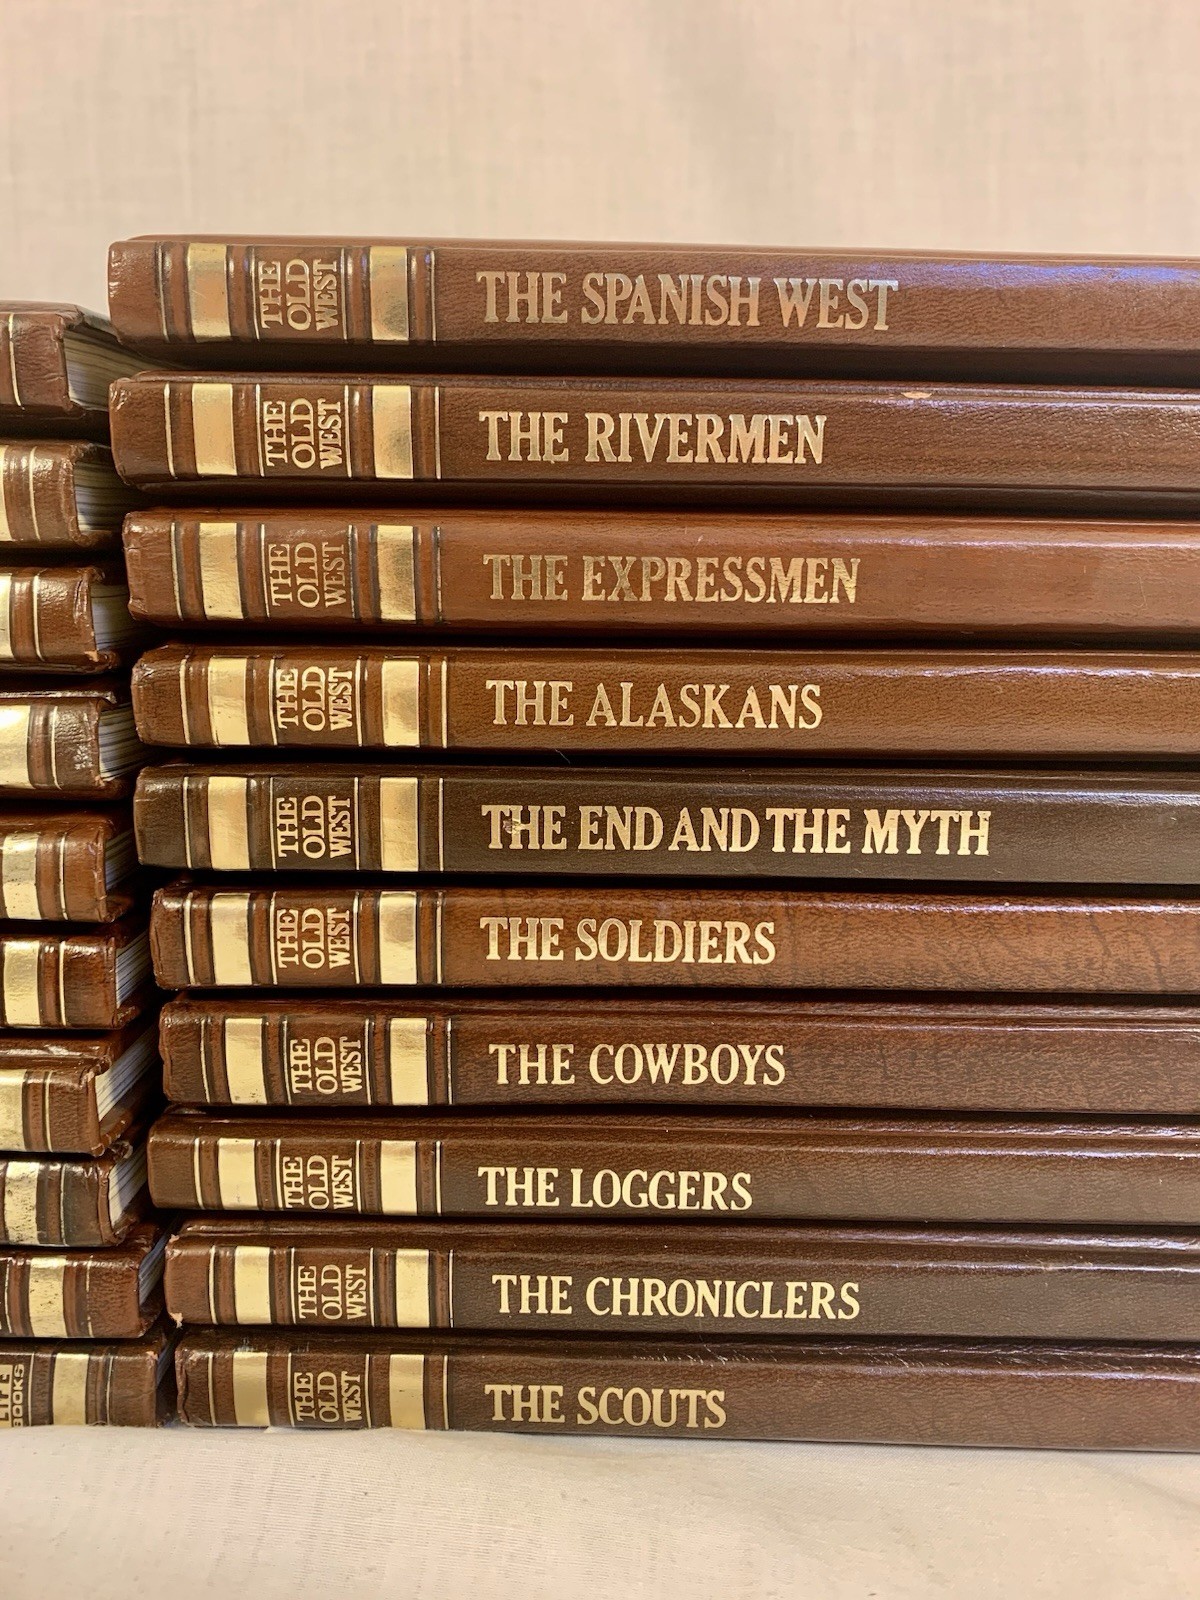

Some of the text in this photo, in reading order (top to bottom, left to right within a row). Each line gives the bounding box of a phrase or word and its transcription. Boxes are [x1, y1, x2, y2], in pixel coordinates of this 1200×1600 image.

[258, 261, 282, 328] THE
[286, 259, 311, 330] OLD
[313, 259, 338, 331] WEST
[476, 272, 899, 331] THE SPANISH WEST
[263, 401, 287, 466] THE
[290, 399, 316, 469] OLD
[317, 398, 342, 470] WEST
[479, 411, 826, 465] THE RIVERMEN
[269, 544, 291, 606] THE
[294, 542, 319, 607] OLD
[322, 542, 347, 608] WEST
[483, 554, 860, 604] THE EXPRESSMEN
[276, 667, 299, 729] THE
[302, 666, 326, 732] OLD
[329, 667, 352, 731] WEST
[486, 679, 823, 729] THE ALASKANS
[277, 797, 299, 858] THE
[302, 795, 326, 859] OLD
[328, 796, 352, 858] WEST
[481, 804, 989, 856] THE END AND THE MYTH
[277, 908, 299, 968] THE
[302, 908, 325, 970] OLD
[327, 908, 351, 969] WEST
[480, 917, 776, 965] THE SOLDIERS
[290, 1039, 312, 1094] THE
[315, 1036, 338, 1094] OLD
[340, 1036, 362, 1093] WEST
[489, 1043, 786, 1086] THE COWBOYS
[283, 1156, 304, 1209] THE
[307, 1155, 329, 1210] OLD
[332, 1155, 353, 1209] WEST
[478, 1166, 752, 1211] THE LOGGERS
[298, 1265, 317, 1319] THE
[321, 1264, 342, 1320] OLD
[346, 1264, 367, 1320] WEST
[492, 1274, 859, 1320] THE CHRONICLERS
[13, 1364, 24, 1428] BOOKS
[294, 1372, 316, 1422] THE
[318, 1371, 340, 1423] OLD
[341, 1370, 362, 1423] WEST
[485, 1384, 726, 1429] THE SCOUTS
